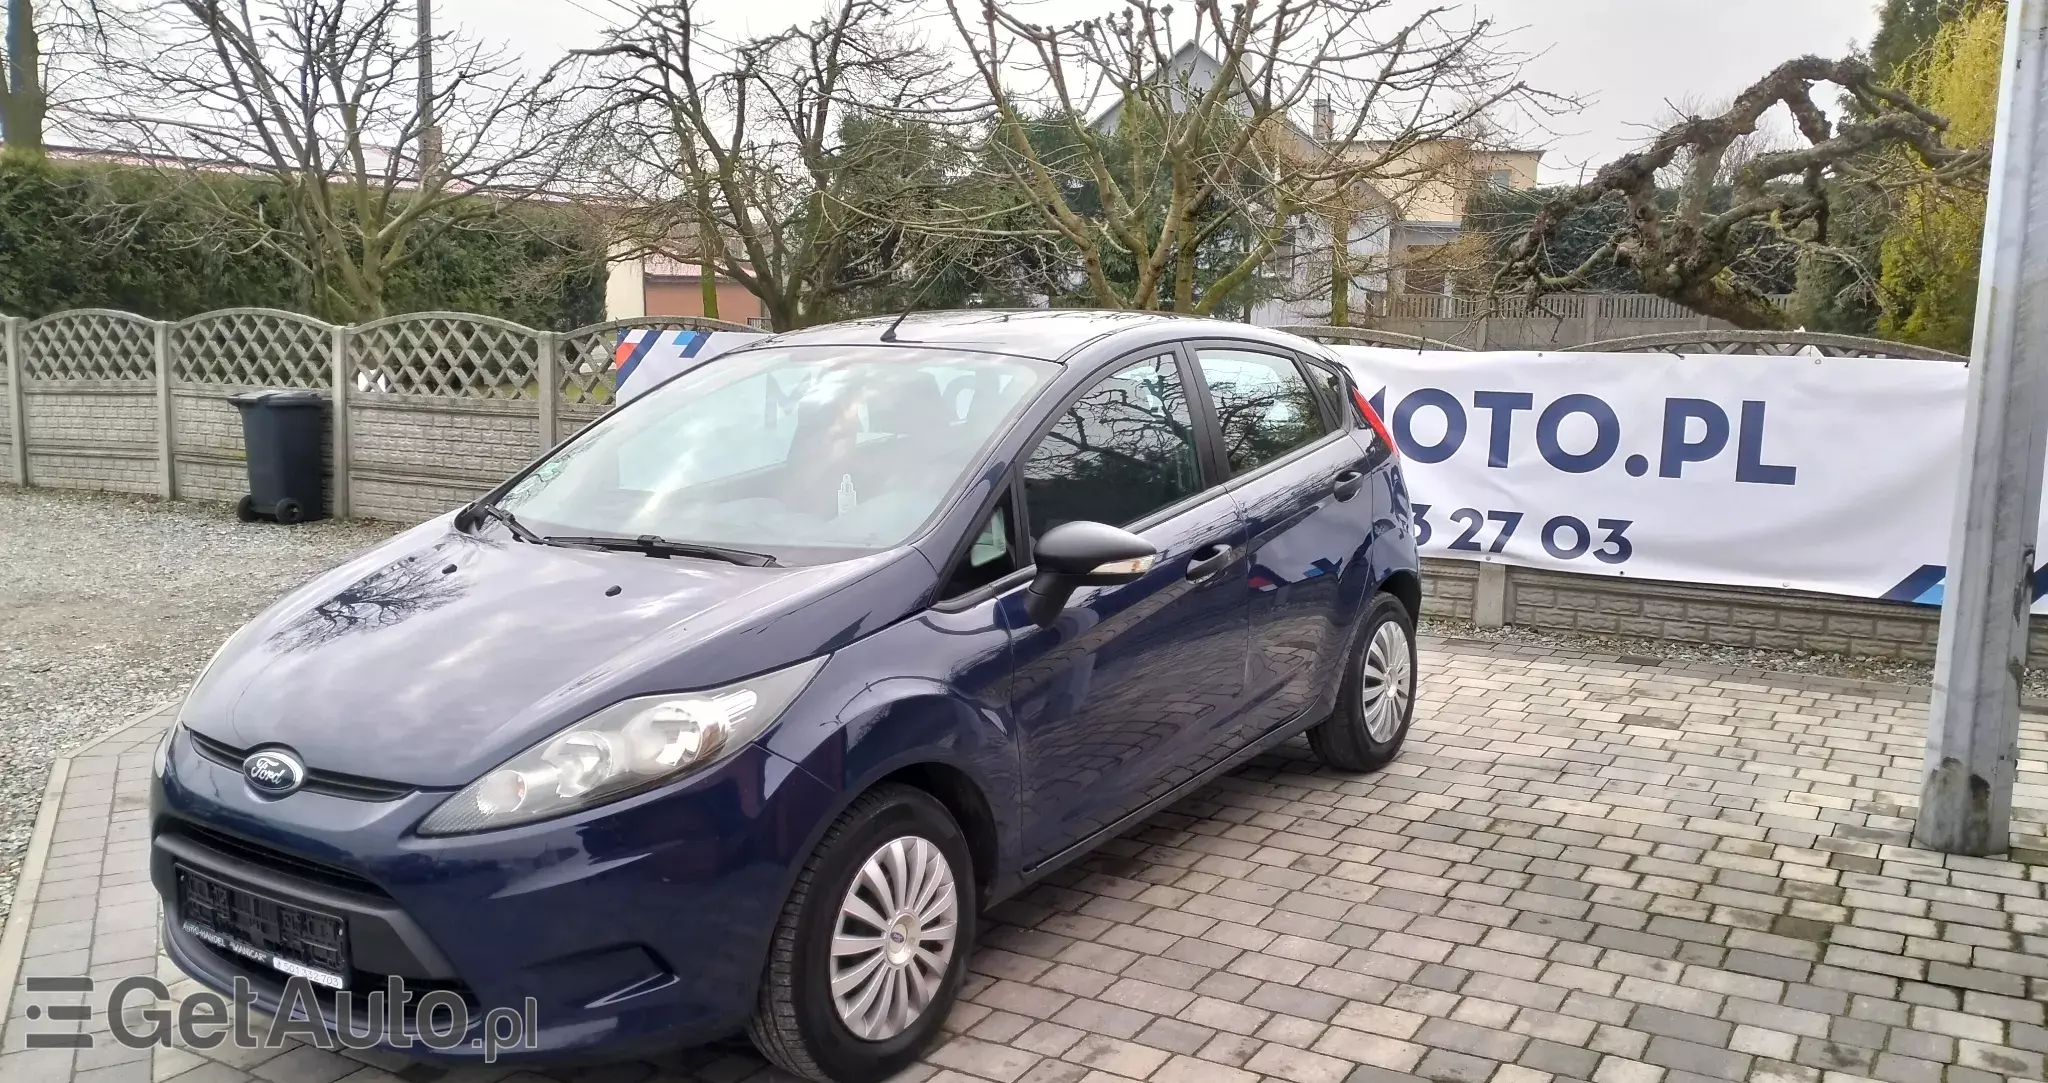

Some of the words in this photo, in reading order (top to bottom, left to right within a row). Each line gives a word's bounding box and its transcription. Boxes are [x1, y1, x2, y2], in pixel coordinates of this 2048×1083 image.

[1447, 508, 1524, 553] 27
[1541, 515, 1634, 565] 03
[251, 757, 287, 784] Ford
